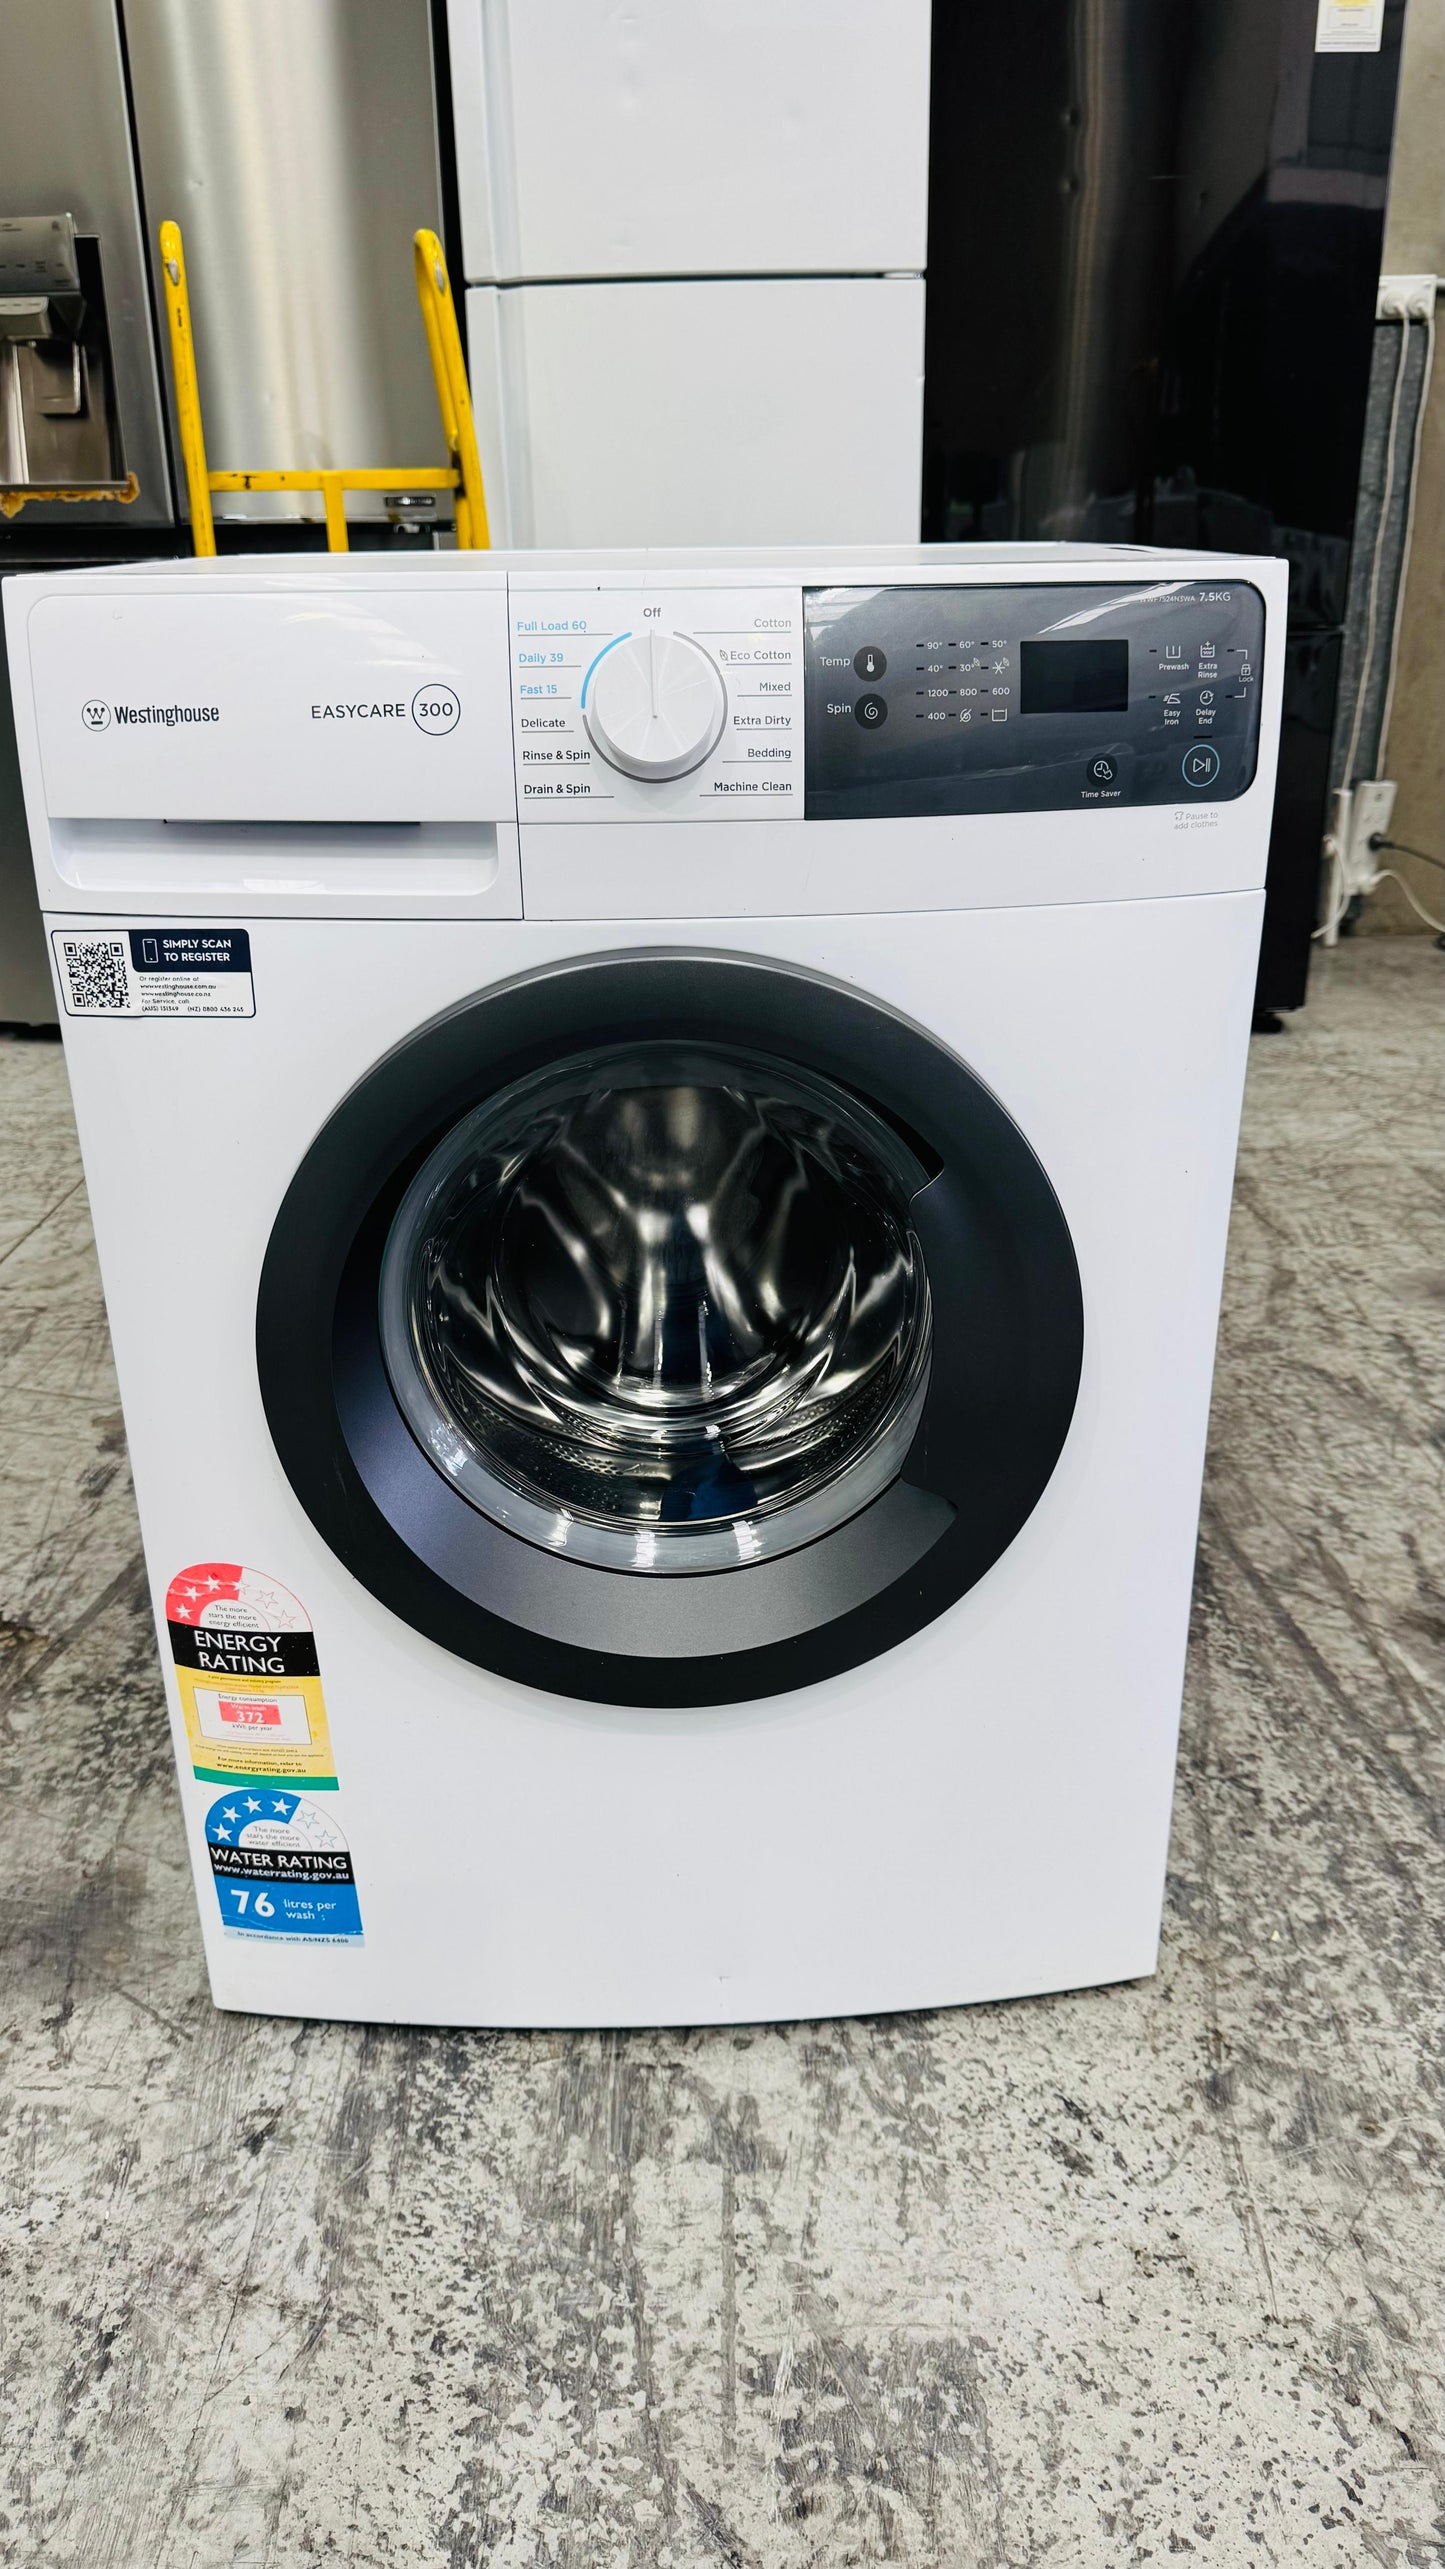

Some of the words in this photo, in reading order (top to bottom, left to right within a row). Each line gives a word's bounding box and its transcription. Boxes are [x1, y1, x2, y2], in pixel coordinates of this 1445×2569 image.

[1199, 592, 1231, 602] 7.5KG
[642, 608, 662, 618] Off
[517, 622, 538, 631] Full
[540, 621, 569, 631] Load
[571, 620, 587, 630] 60
[754, 618, 792, 628] Cotton
[927, 642, 942, 650] 90°
[519, 653, 548, 664] Daily
[550, 653, 564, 662] 39
[730, 650, 751, 660] Eco
[753, 650, 792, 660] Cotton
[820, 657, 850, 667] Temp
[520, 685, 543, 694] Fast
[546, 685, 558, 694] 15
[759, 682, 791, 692] Mixed
[928, 689, 948, 697] 1200
[311, 703, 406, 719] EASYCARE
[418, 703, 454, 717] 300
[827, 704, 852, 715] Spin
[1196, 709, 1216, 717] Delay
[114, 705, 220, 727] Westinghouse
[733, 716, 762, 725] Extra
[764, 715, 792, 727] Dirty
[928, 712, 946, 720] 400
[521, 718, 566, 728] Delicate
[522, 750, 554, 760] Rinse
[556, 750, 564, 760] &
[565, 750, 590, 762] Spin
[747, 748, 792, 760] Bedding
[524, 784, 554, 794] Drain
[556, 784, 564, 793] &
[566, 784, 590, 796] Spin
[714, 782, 759, 792] Machine
[761, 782, 792, 791] Clean
[163, 939, 200, 949] SIMPLY
[202, 939, 231, 948] SCAN
[164, 952, 180, 961] TO
[182, 952, 230, 962] REGISTER
[194, 1631, 282, 1653] ENERGY
[198, 1652, 285, 1673] RATING
[237, 1711, 264, 1723] 372
[217, 1763, 306, 1773] www.energyrating.gov.au
[210, 1847, 273, 1867] WATER
[278, 1855, 347, 1869] RATING
[214, 1864, 350, 1881] www.waterrating.gov.au
[231, 1889, 275, 1918] 76
[283, 1899, 313, 1910] litres
[317, 1901, 337, 1911] per
[286, 1910, 315, 1920] wash
